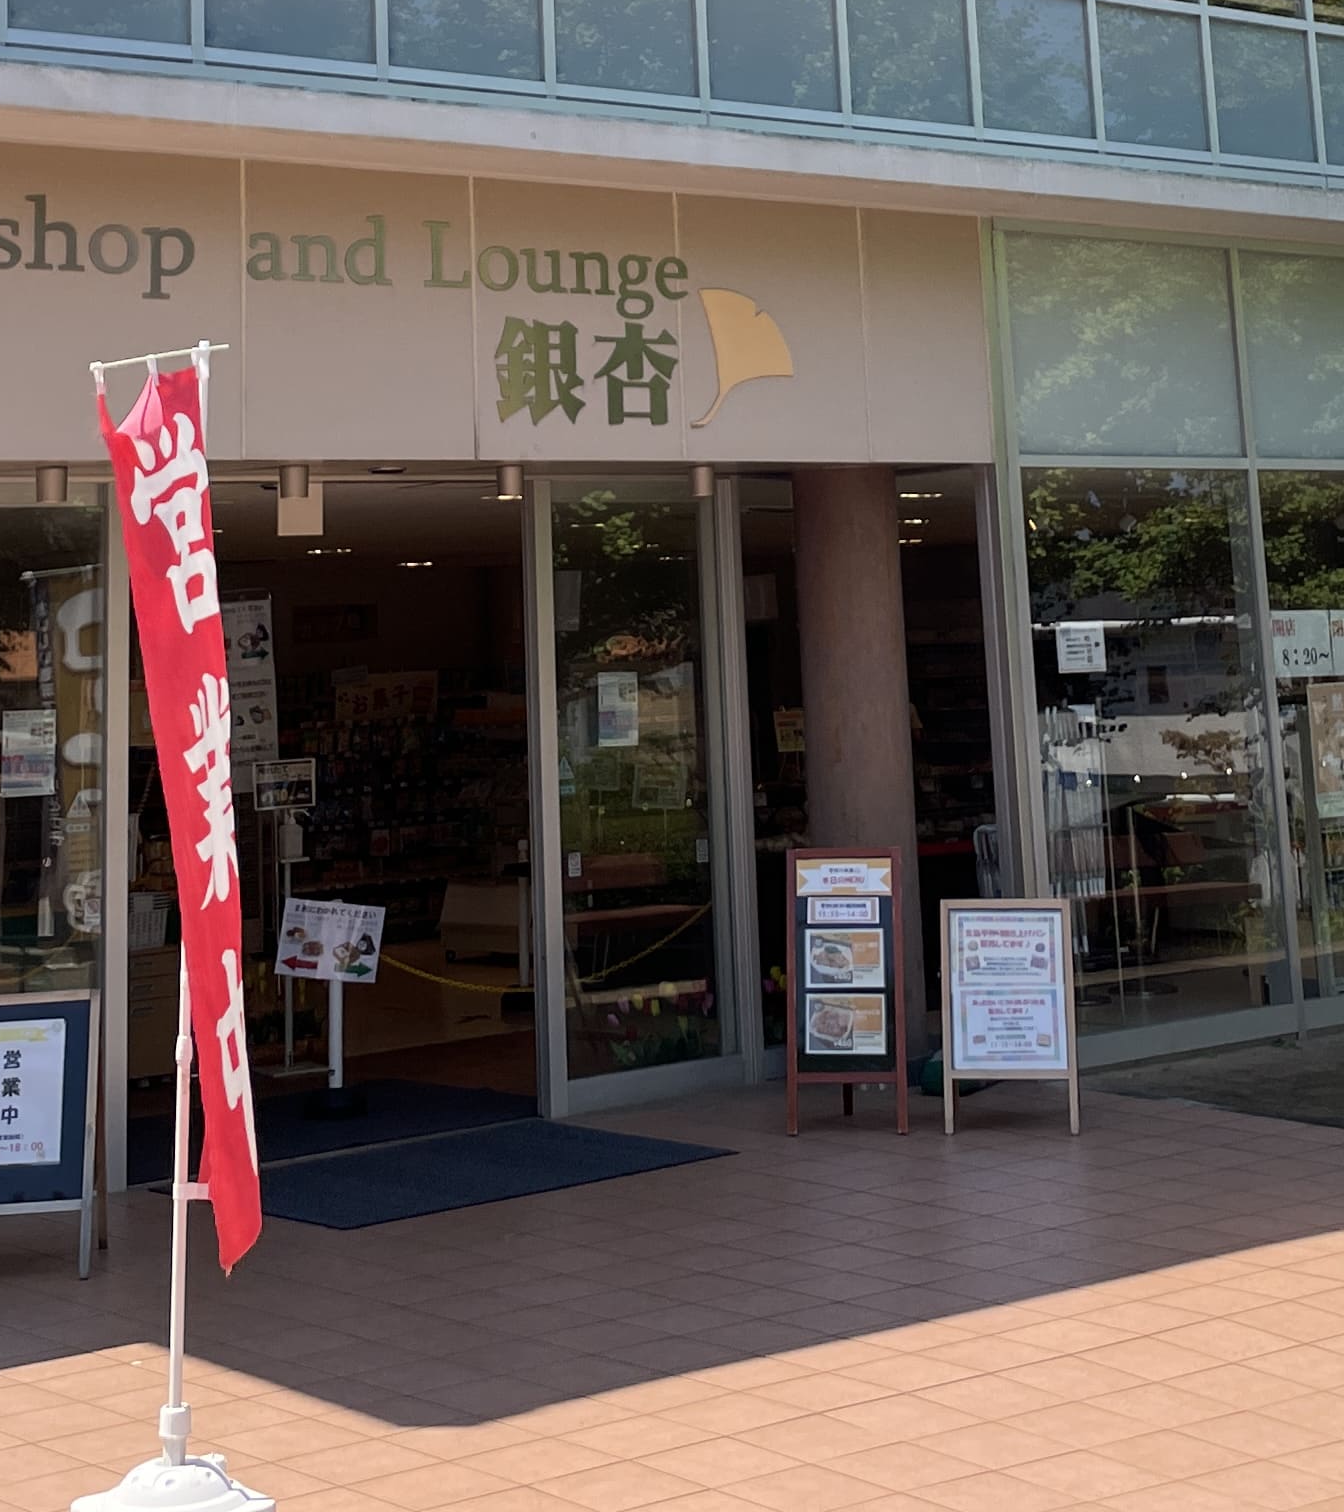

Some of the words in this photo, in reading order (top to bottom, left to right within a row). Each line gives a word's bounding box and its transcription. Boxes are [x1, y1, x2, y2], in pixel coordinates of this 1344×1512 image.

[244, 215, 393, 287] and
[422, 220, 690, 319] Lounge
[492, 316, 680, 427] 銀杏
[0, 1049, 22, 1126] 営業中
